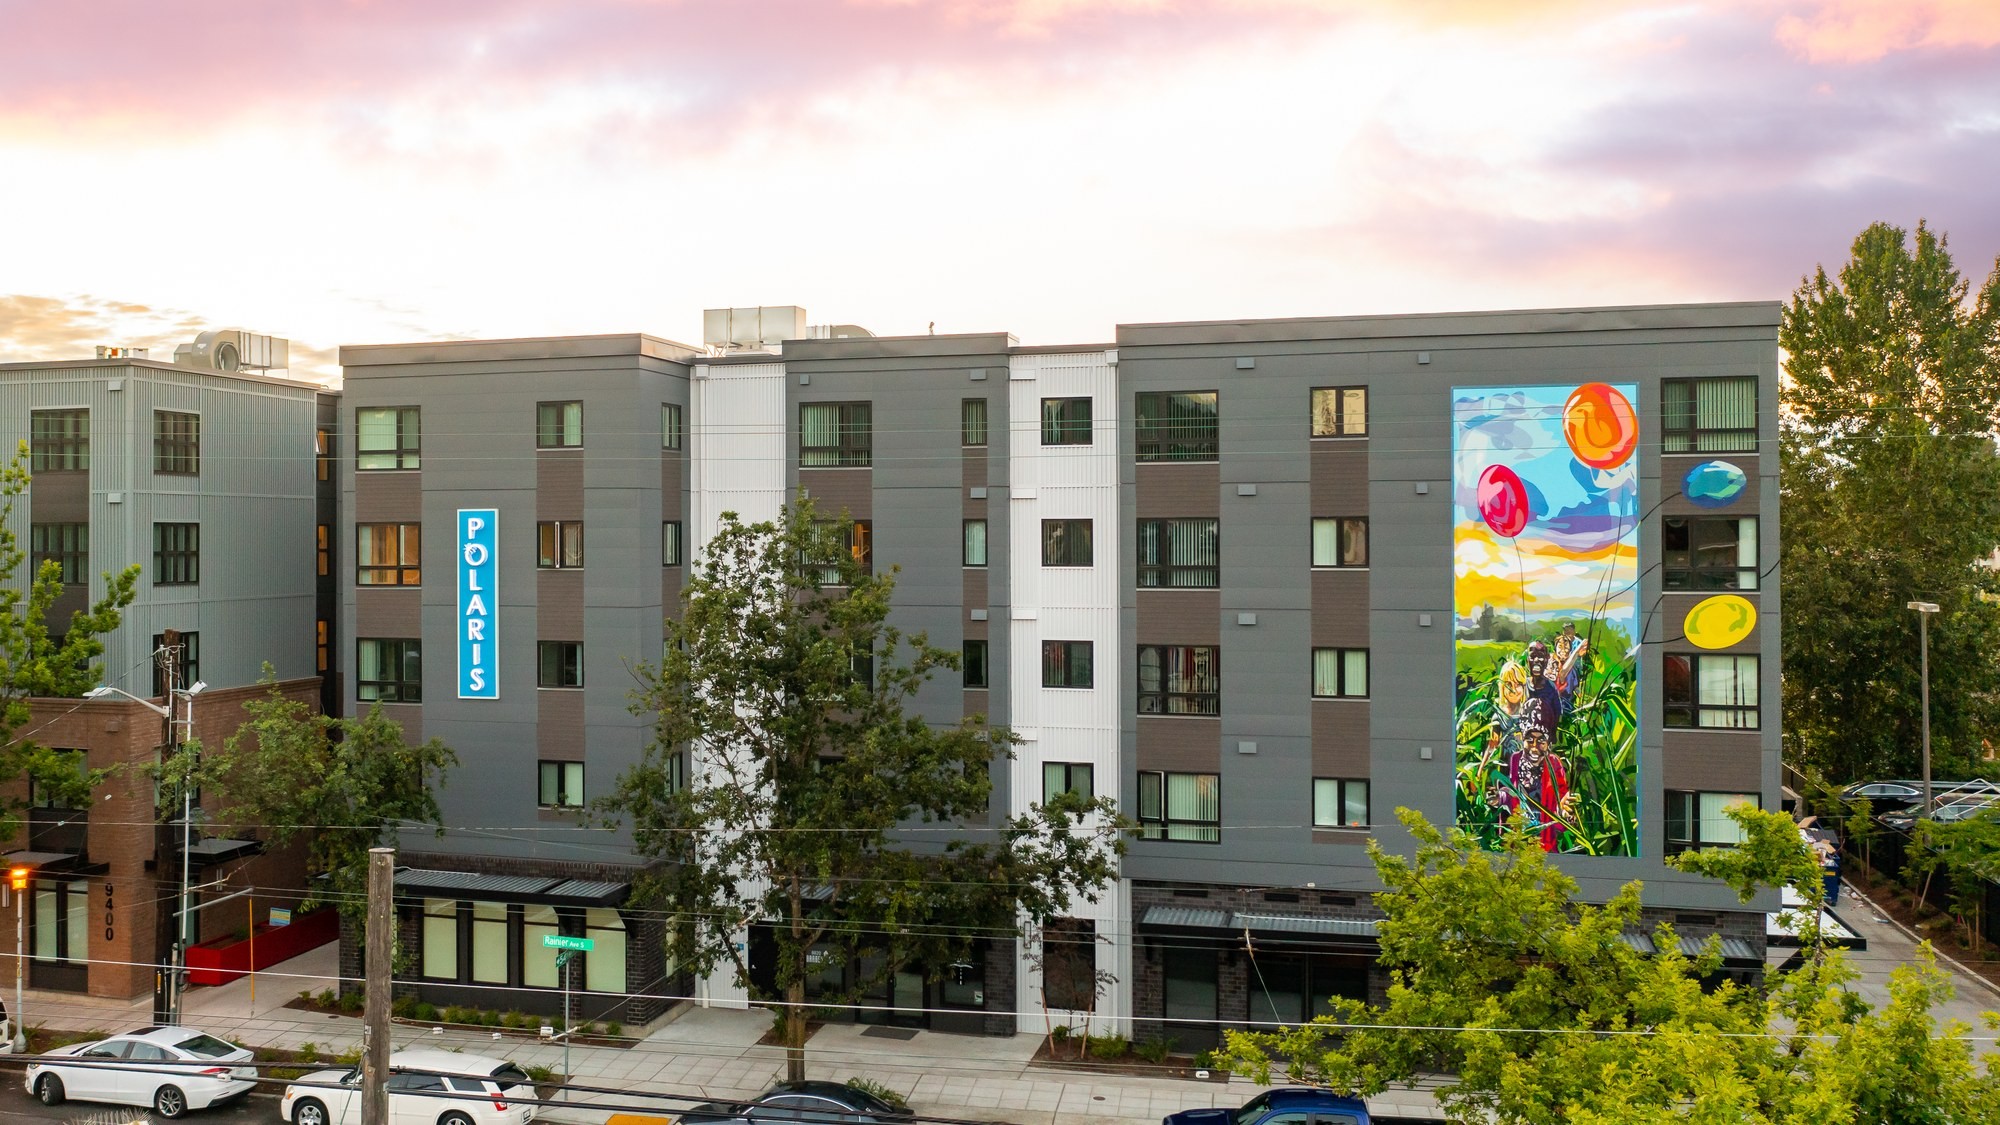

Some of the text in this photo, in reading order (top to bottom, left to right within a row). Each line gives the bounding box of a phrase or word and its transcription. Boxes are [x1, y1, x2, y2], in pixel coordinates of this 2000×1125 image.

[463, 517, 488, 691] POLARIS
[105, 882, 114, 941] 9400
[544, 936, 569, 947] Rainier
